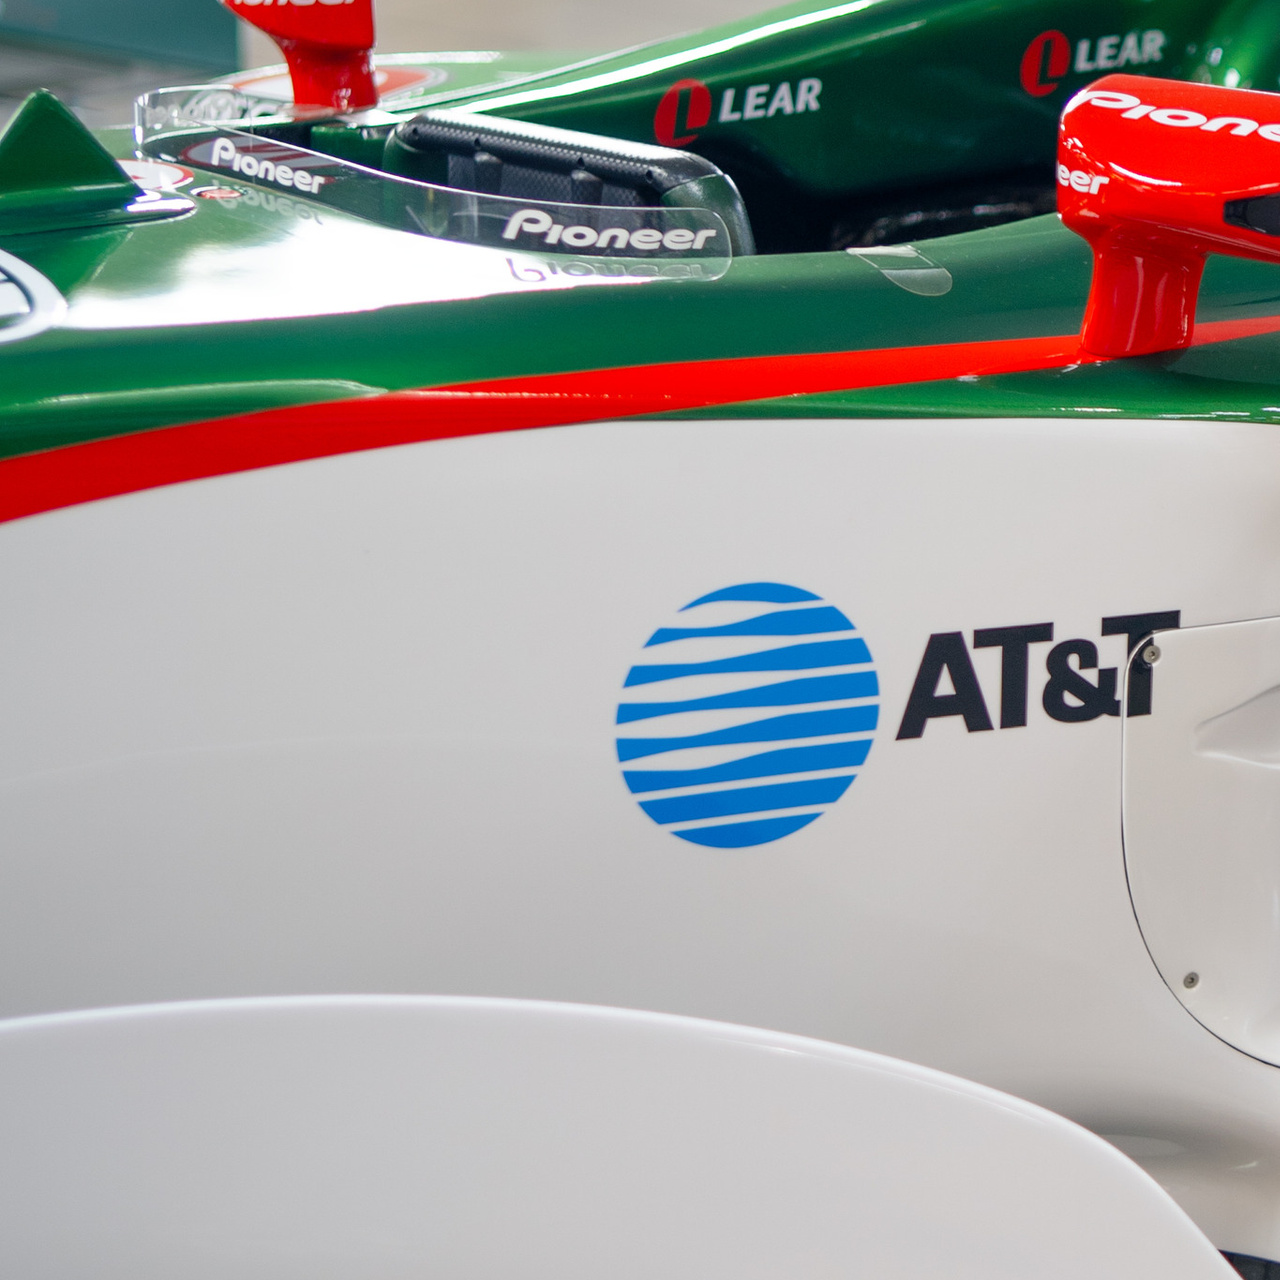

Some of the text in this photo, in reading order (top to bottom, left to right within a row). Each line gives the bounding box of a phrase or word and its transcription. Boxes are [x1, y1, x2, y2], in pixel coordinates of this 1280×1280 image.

[1074, 29, 1167, 74] LEAR
[717, 76, 823, 124] LEAR
[211, 136, 326, 195] Pioneer
[501, 208, 718, 251] Pioneer
[894, 609, 1181, 742] AT&T
